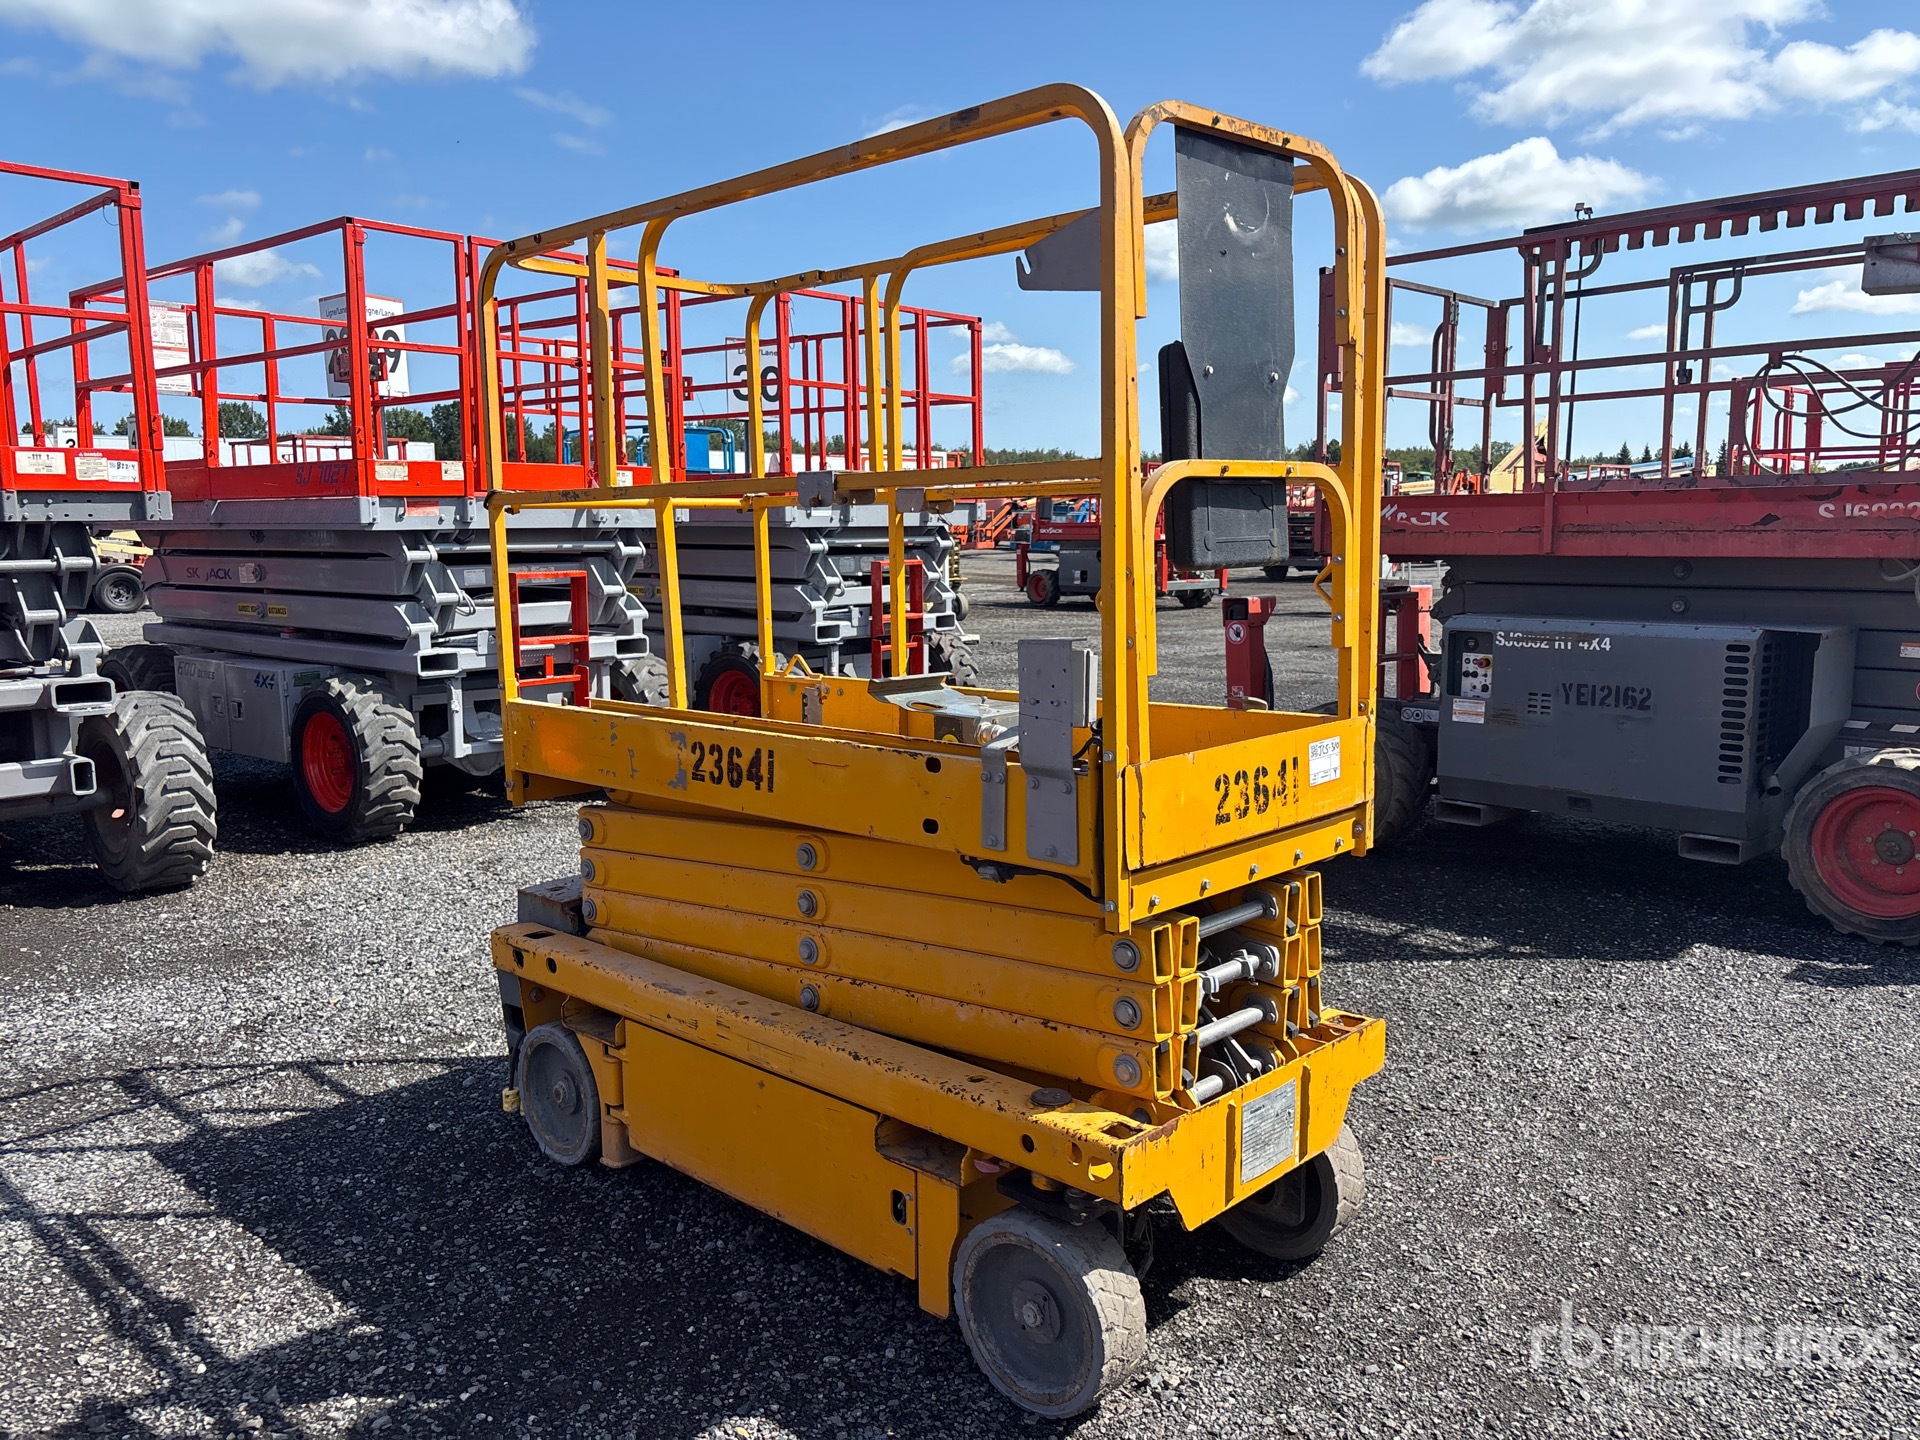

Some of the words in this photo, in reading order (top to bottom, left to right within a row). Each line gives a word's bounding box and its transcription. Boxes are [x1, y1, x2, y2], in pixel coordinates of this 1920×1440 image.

[325, 307, 346, 318] Ligne/Lan
[366, 306, 395, 317] igne/Lane
[1578, 637, 1612, 652] 4X4
